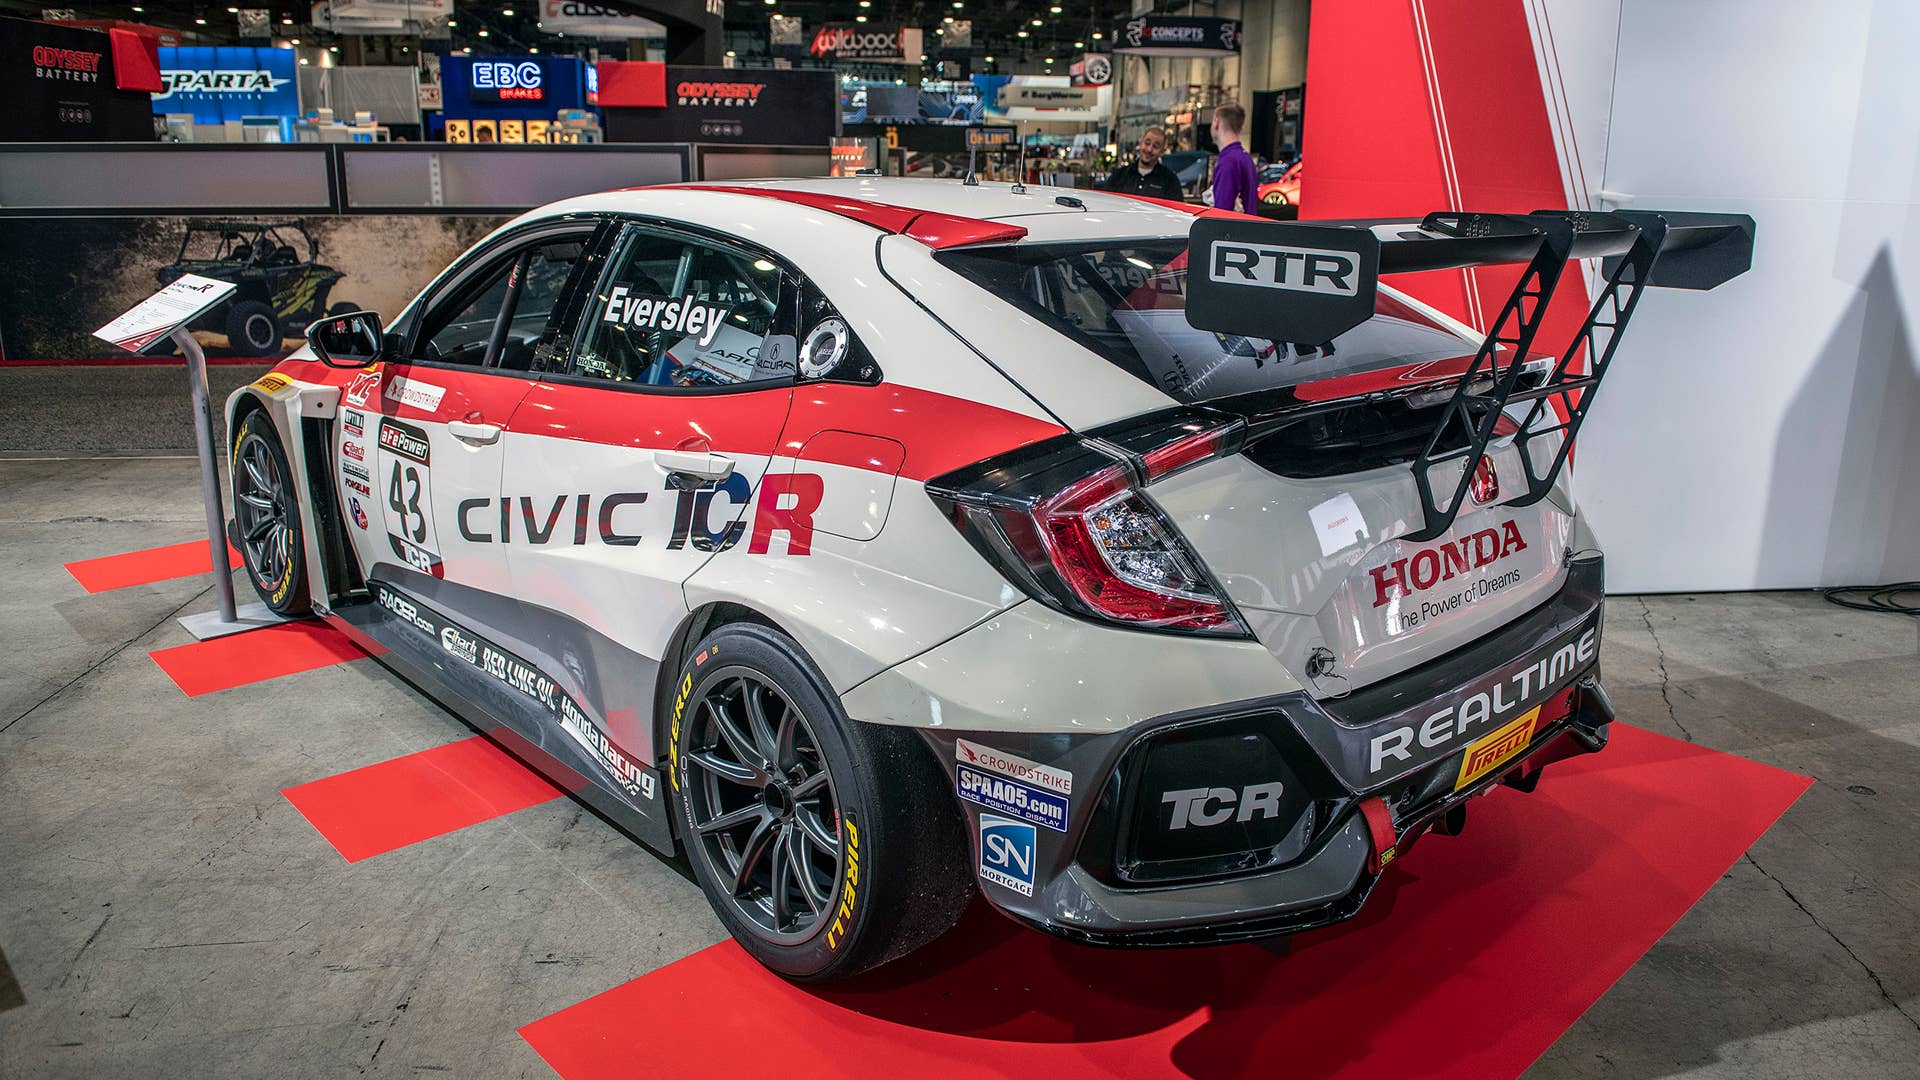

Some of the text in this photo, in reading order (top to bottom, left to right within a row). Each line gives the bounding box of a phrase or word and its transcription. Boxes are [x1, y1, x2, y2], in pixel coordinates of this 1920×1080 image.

[32, 45, 100, 73] ODYSSEY
[35, 67, 99, 83] BATTERY
[472, 61, 542, 89] EBC
[499, 87, 543, 100] BRAKES
[676, 81, 763, 98] ODYSSEY
[677, 97, 759, 107] BATTERY
[1214, 245, 1354, 291] RTR
[603, 286, 727, 347] Eversley
[388, 459, 427, 545] 43
[457, 471, 825, 557] CIVIC TCR
[400, 539, 433, 576] TCR
[1368, 519, 1528, 609] HONDA
[1421, 592, 1463, 622] Power
[1464, 582, 1477, 604] of
[1479, 566, 1521, 599] Dreams
[440, 627, 478, 658] Eibach
[482, 646, 506, 680] RED
[507, 660, 537, 698] LINE
[536, 676, 556, 711] OIL
[1369, 626, 1595, 774] REALTIME
[560, 694, 600, 747] Honda
[599, 733, 656, 801] Racing
[1463, 717, 1536, 779] PIRELLI
[960, 769, 1063, 821] SPAA05.com
[979, 753, 1072, 792] CROWDSTRIKE
[960, 789, 1061, 828] RACE POSITION DISPLAY
[1160, 780, 1285, 831] TCR
[985, 833, 1032, 876] SN
[826, 818, 860, 950] PIRELLI
[980, 868, 1033, 896] MORTGAGE
